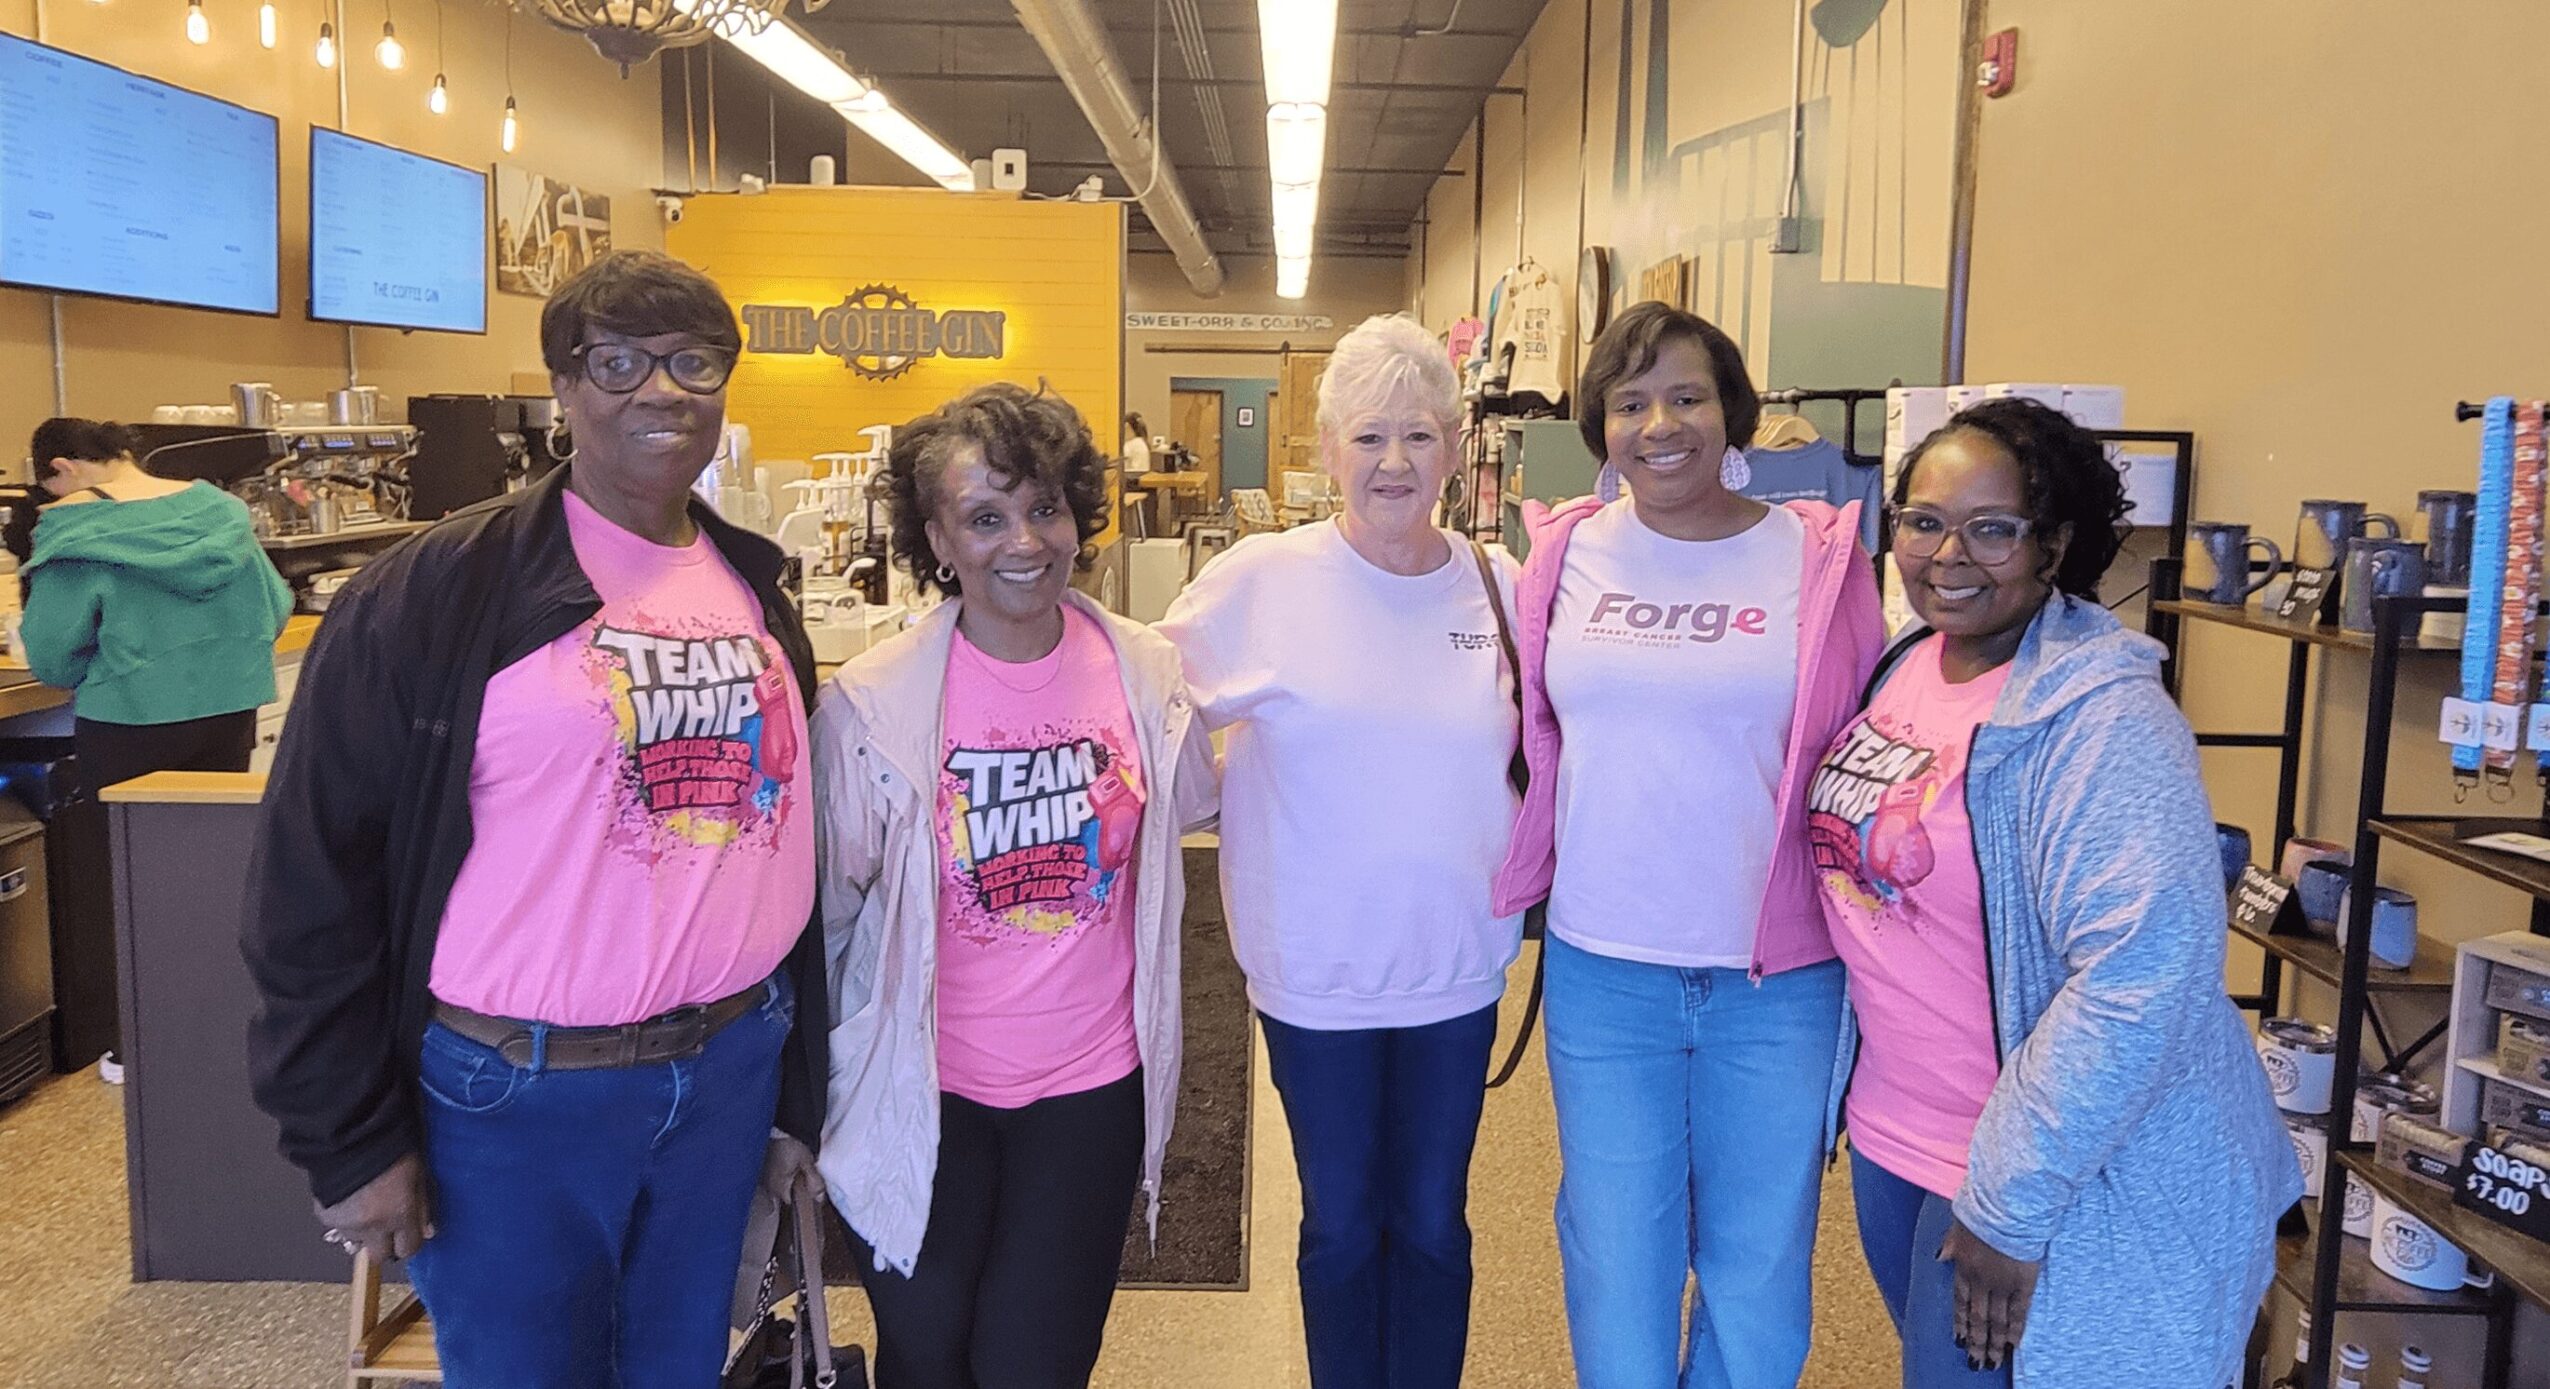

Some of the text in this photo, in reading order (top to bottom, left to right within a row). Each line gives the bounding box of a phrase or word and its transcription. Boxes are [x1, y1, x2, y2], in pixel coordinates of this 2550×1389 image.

[750, 309, 1001, 354] THE COFFEE GIN
[1240, 316, 1254, 328] &
[1584, 627, 1681, 640] BREAST CANCER
[1589, 592, 1767, 643] Forge
[596, 628, 764, 686] TEAM
[1581, 635, 1681, 649] SURVIVOR CENTER
[631, 682, 760, 745] WHIP
[721, 741, 752, 761] TO
[1829, 720, 1934, 784] TEAM
[948, 741, 1097, 808] TEAM
[1810, 767, 1890, 825] WHIP
[966, 790, 1096, 860] WHIP
[977, 843, 1086, 876] WORKING TO
[981, 861, 1088, 892] HELP THOSE
[990, 879, 1072, 911] IN PINK
[2466, 1173, 2531, 1215] $7.00
